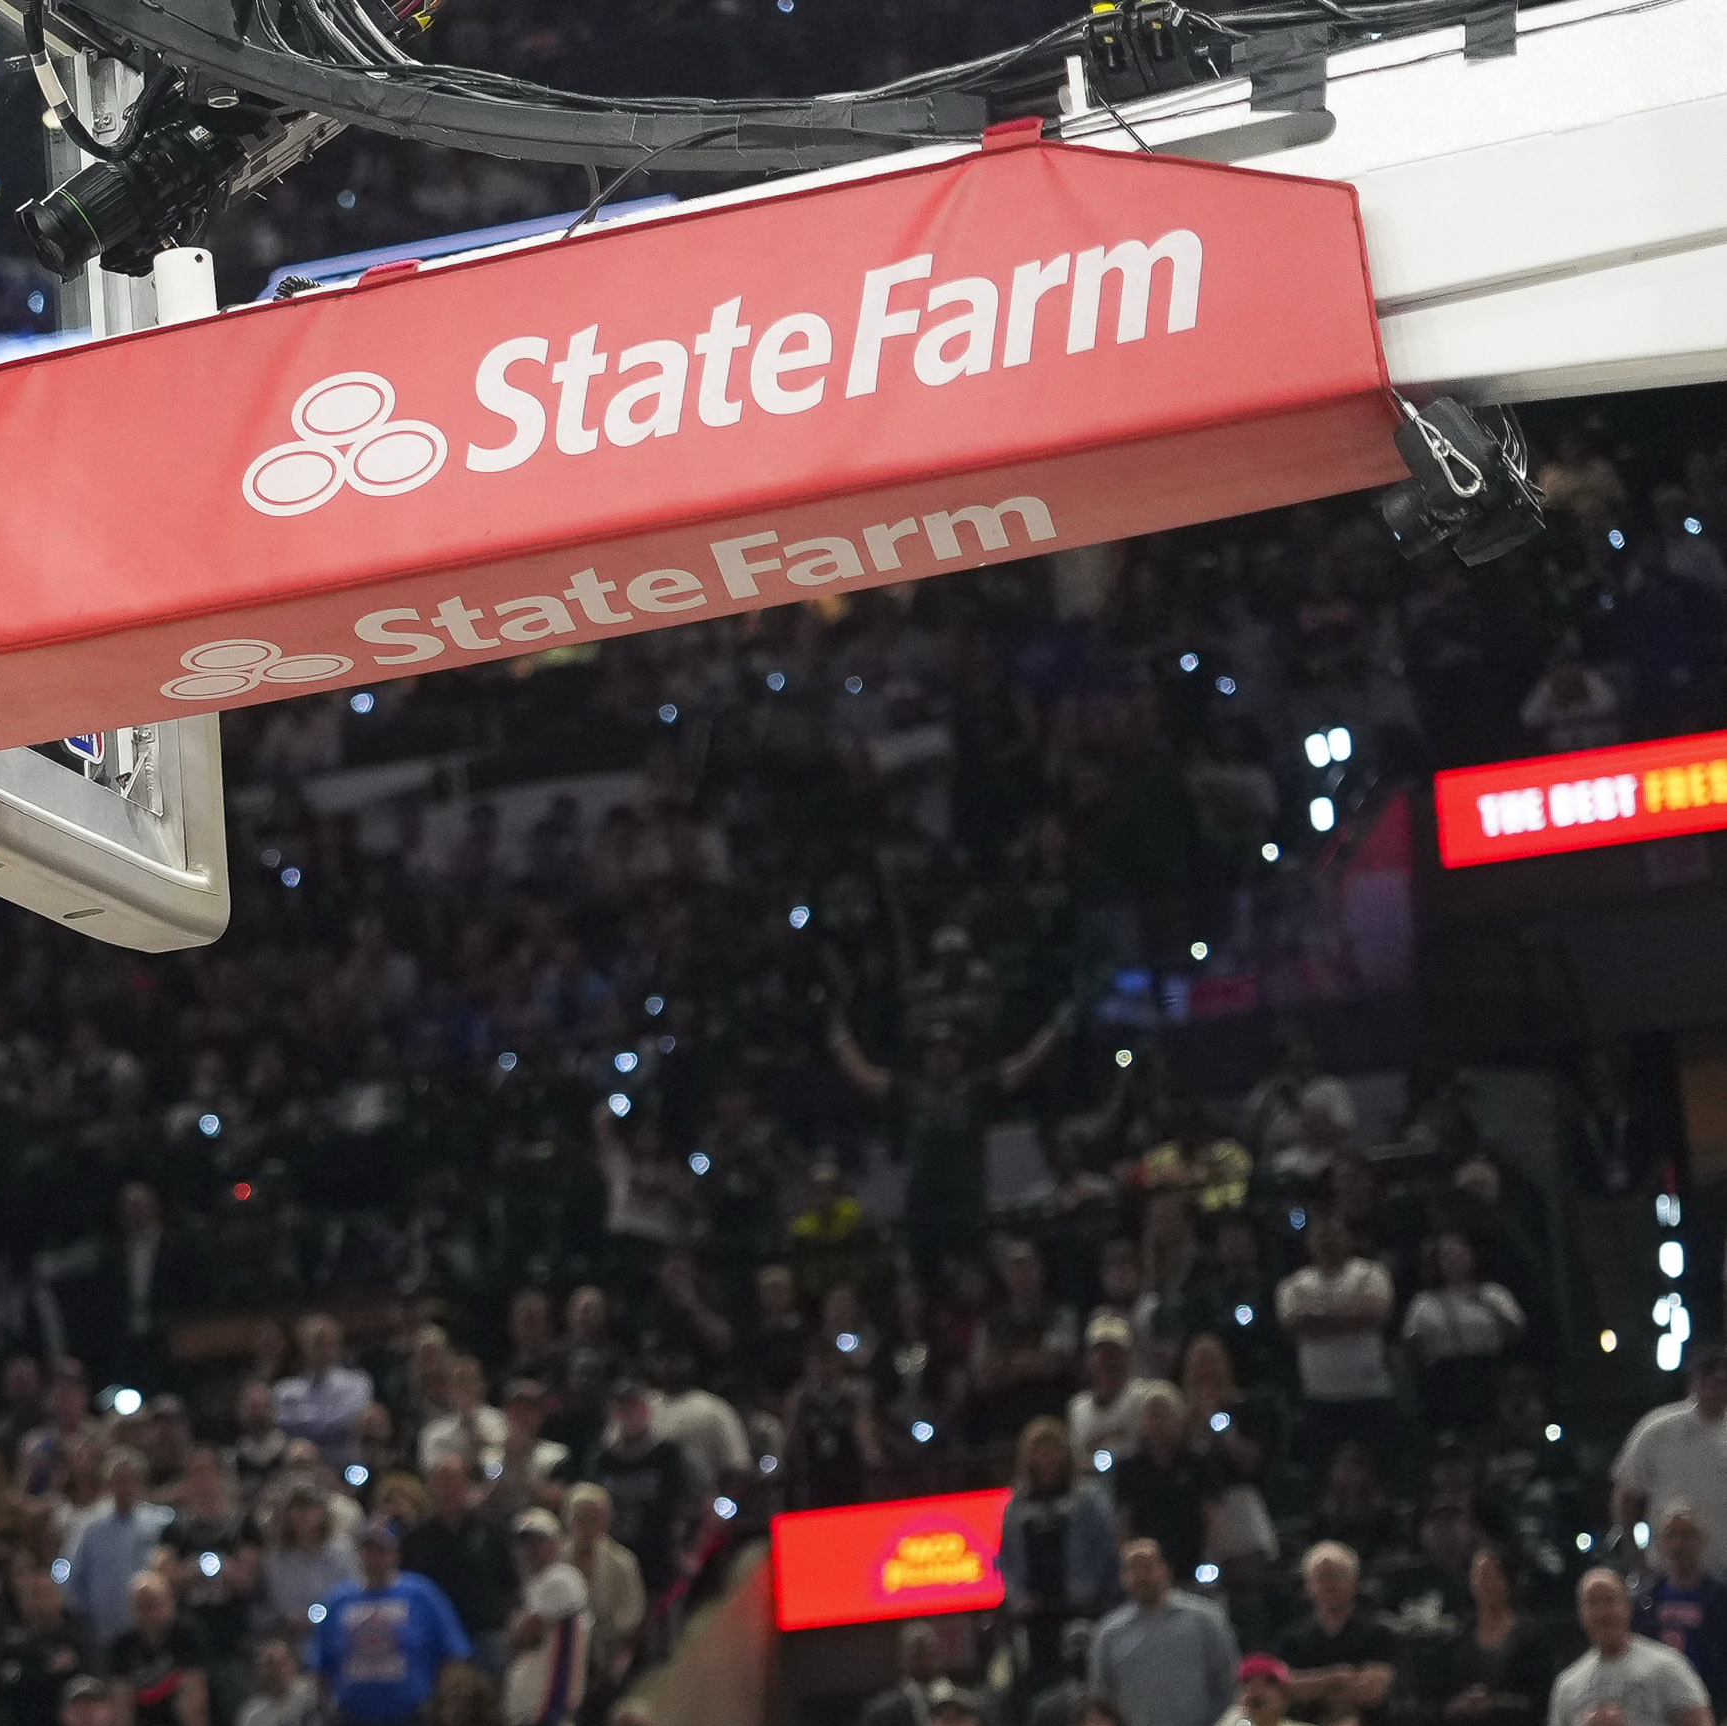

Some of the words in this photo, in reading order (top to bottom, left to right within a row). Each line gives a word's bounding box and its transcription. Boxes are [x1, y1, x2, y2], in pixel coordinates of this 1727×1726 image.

[465, 295, 833, 474] State
[845, 228, 1205, 399] Farm
[354, 567, 708, 665] State
[709, 495, 1057, 600] Farm
[1478, 787, 1546, 838] THE
[1548, 773, 1637, 829] BEST
